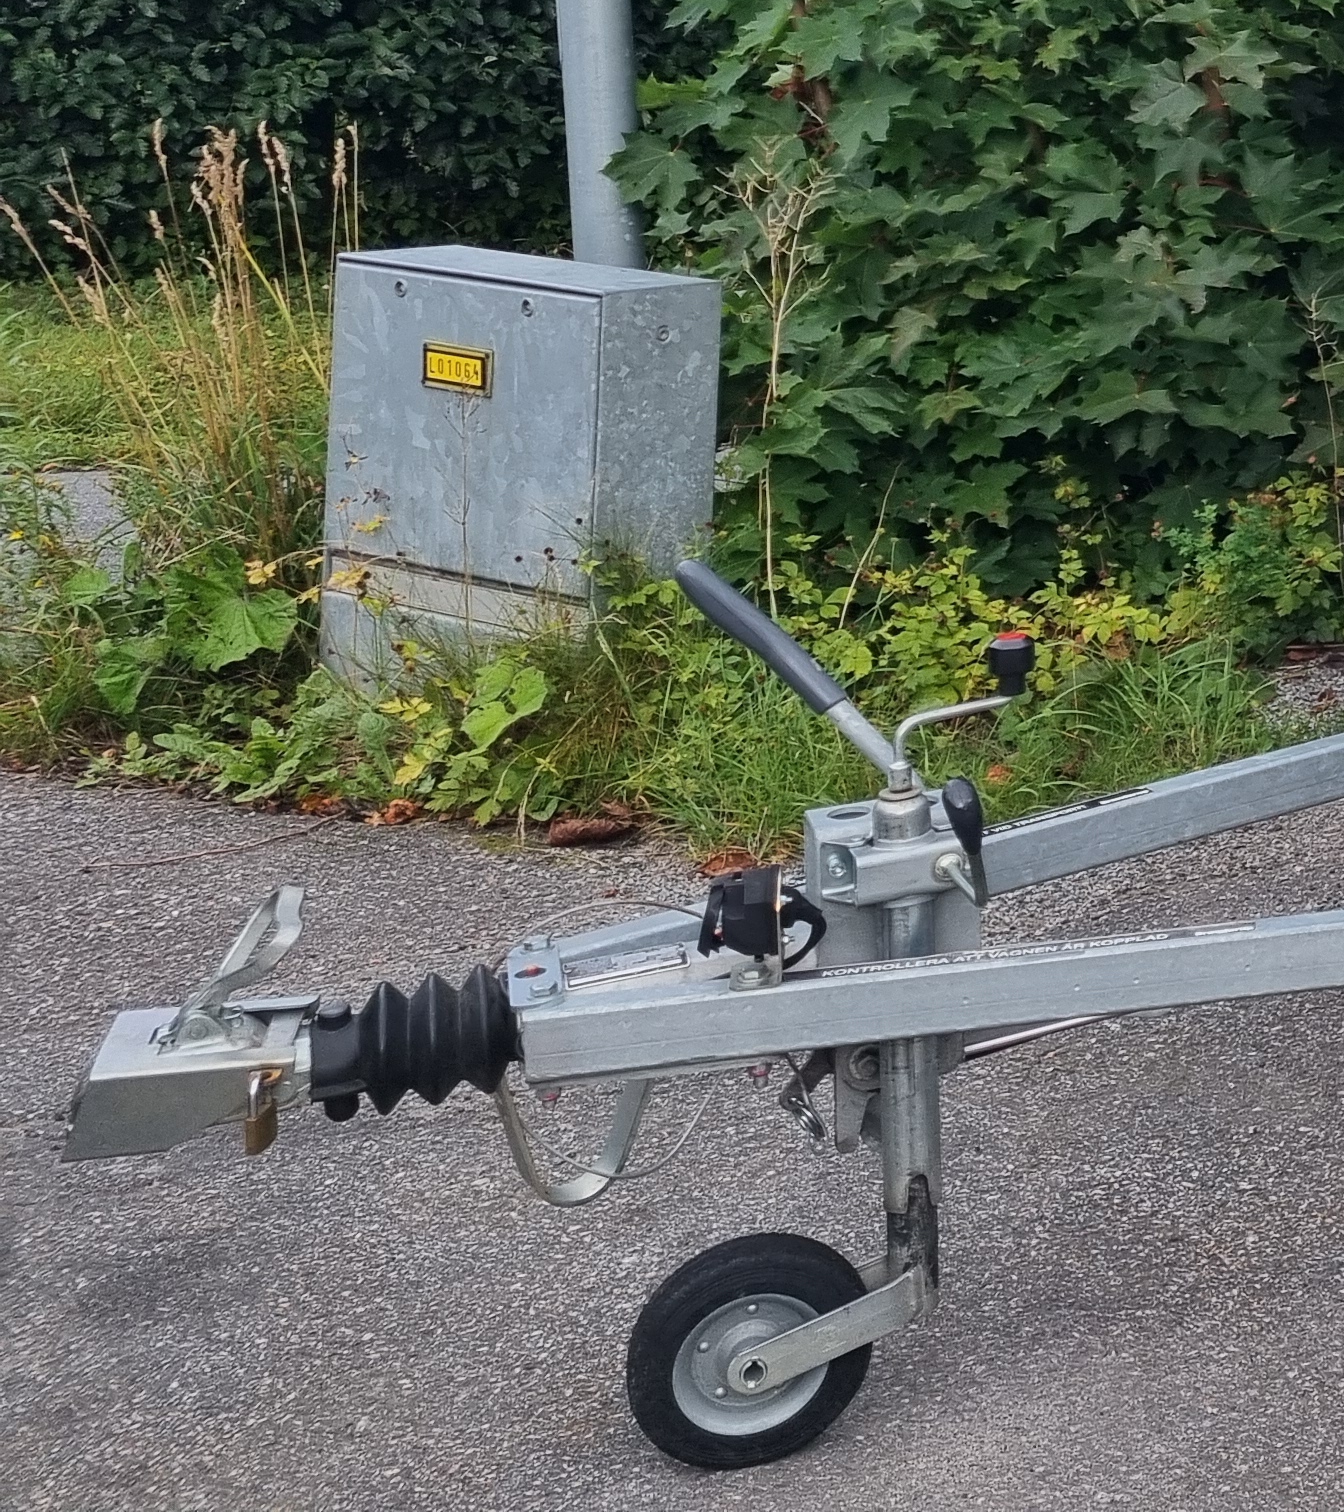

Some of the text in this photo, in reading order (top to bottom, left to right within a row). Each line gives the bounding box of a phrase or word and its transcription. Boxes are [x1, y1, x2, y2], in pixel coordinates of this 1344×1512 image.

[821, 956, 949, 978] KONTROLLERA
[952, 953, 983, 963] ATT
[987, 945, 1058, 959] VAGNEN
[1089, 933, 1168, 948] KOPPLAD
